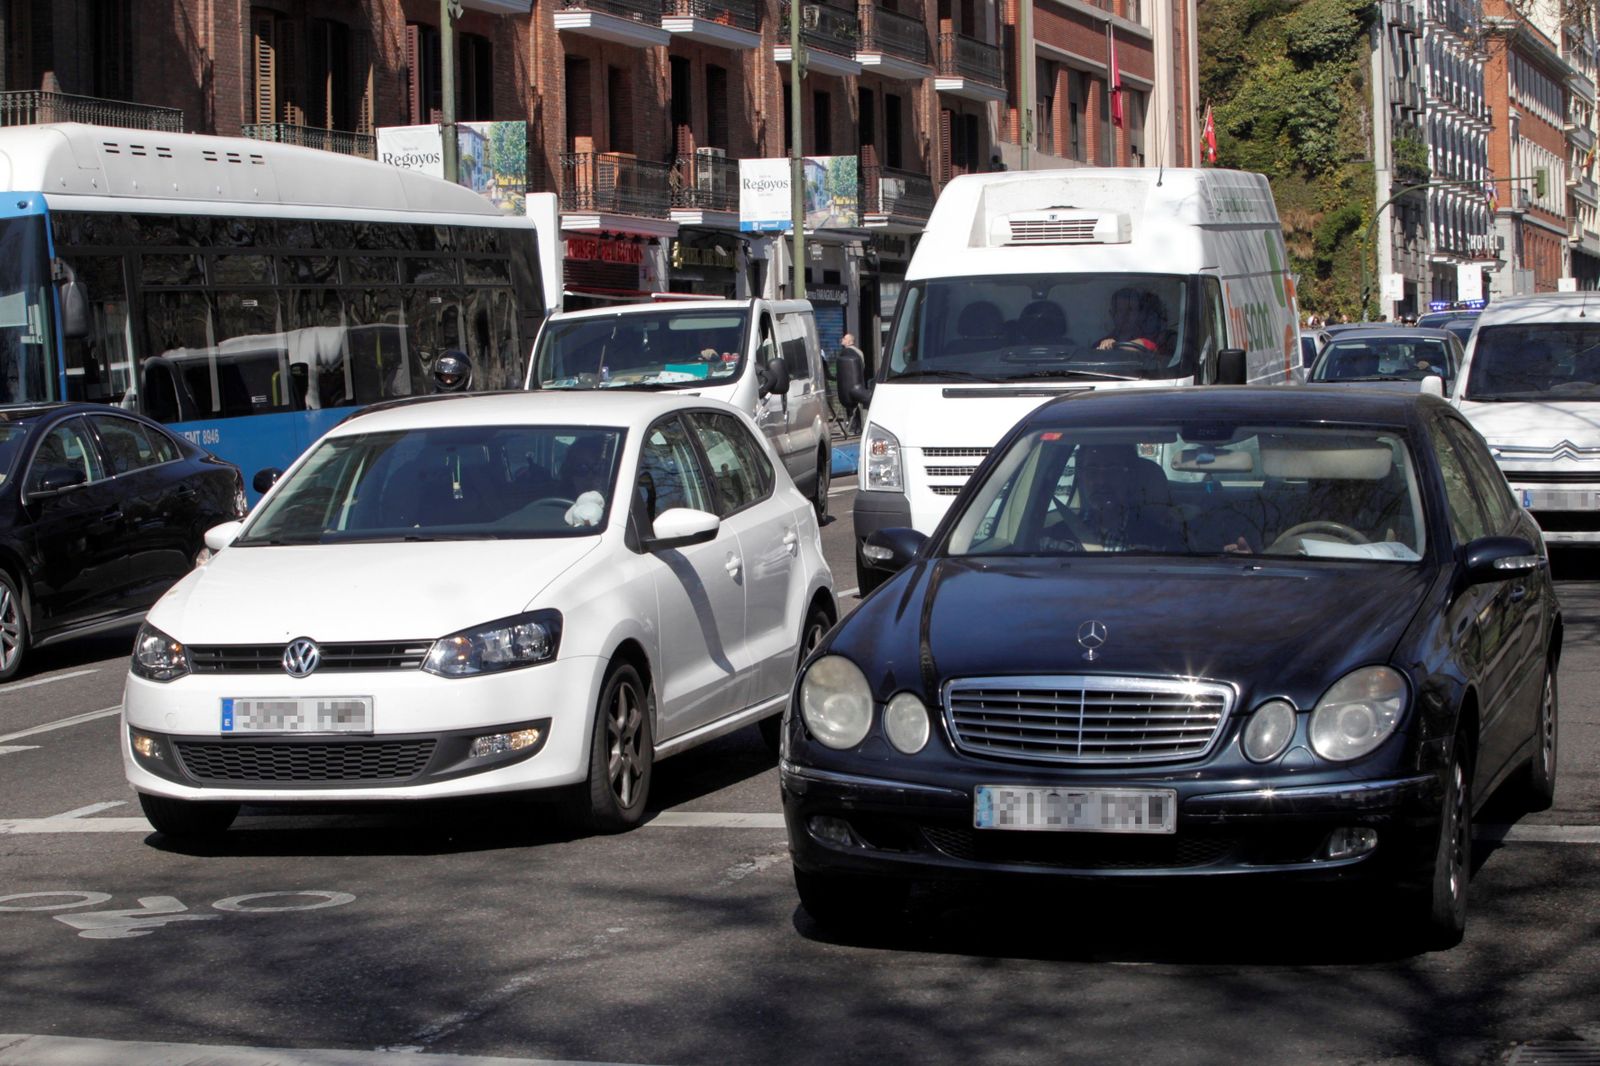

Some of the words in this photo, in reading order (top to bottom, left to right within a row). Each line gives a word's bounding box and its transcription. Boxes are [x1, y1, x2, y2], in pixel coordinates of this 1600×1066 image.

[382, 152, 441, 168] Regoyos
[743, 177, 789, 192] Regoyos
[1470, 234, 1499, 250] HOTEL
[202, 428, 220, 445] 8946
